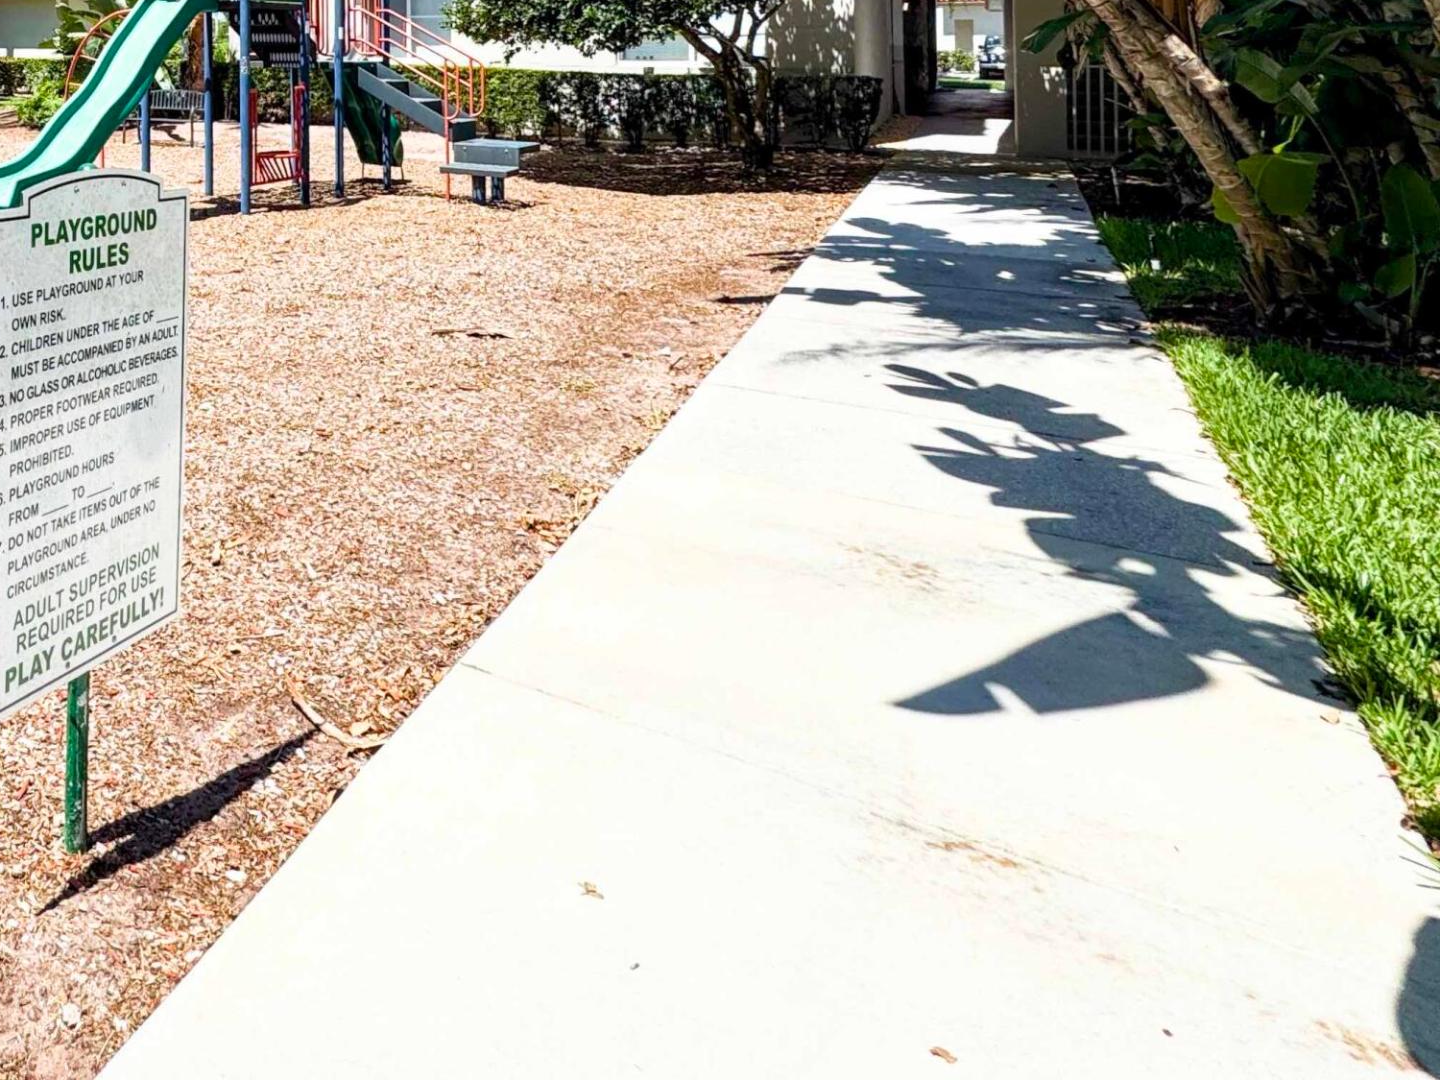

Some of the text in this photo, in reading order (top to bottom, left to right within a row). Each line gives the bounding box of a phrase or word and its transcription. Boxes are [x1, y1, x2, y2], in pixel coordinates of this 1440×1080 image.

[31, 208, 157, 248] PLAYGROUND
[69, 242, 129, 274] RULES
[0, 270, 144, 310] 1. USE PLAYGROUND AT YOUR
[0, 310, 155, 359] 2. CHILDREN UNDER THE AGE OF
[11, 309, 66, 332] OWN RISK.
[11, 361, 40, 381] MUST
[42, 357, 56, 372] BE
[57, 339, 123, 367] ACCOMPANIED
[125, 335, 138, 350] BY
[139, 331, 150, 345] AN
[10, 388, 25, 406] NO
[26, 380, 59, 400] GLASS
[61, 375, 75, 390] OR
[76, 360, 126, 386] ALCOHOLIC
[10, 403, 54, 430] PROPER
[56, 386, 110, 416] FOOTWEAR
[10, 423, 64, 454] IMPROPER
[66, 416, 86, 435] USE
[88, 411, 102, 427] OF
[103, 394, 155, 423] EQUIPMENT
[9, 444, 74, 477] PROHIBITED.
[9, 463, 79, 503] PLAYGROUND
[81, 451, 115, 474] HOURS
[8, 485, 85, 527] FROM TO
[8, 533, 24, 551] DO
[26, 522, 49, 543] NOT
[50, 511, 77, 531] TAKE
[79, 498, 107, 521] ITEMS
[109, 490, 128, 508] OUT
[130, 484, 142, 499] OF
[143, 476, 161, 493] THE
[7, 534, 78, 575] PLAYGROUND
[110, 506, 141, 529] UNDER
[143, 500, 156, 515] NO
[7, 552, 89, 599] CIRCUMSTANCE.
[13, 542, 160, 631] ADULT SUPERVISION
[16, 566, 157, 654] REQUIRED FOR USE
[5, 586, 164, 694] PLAY CAREFULLY!
